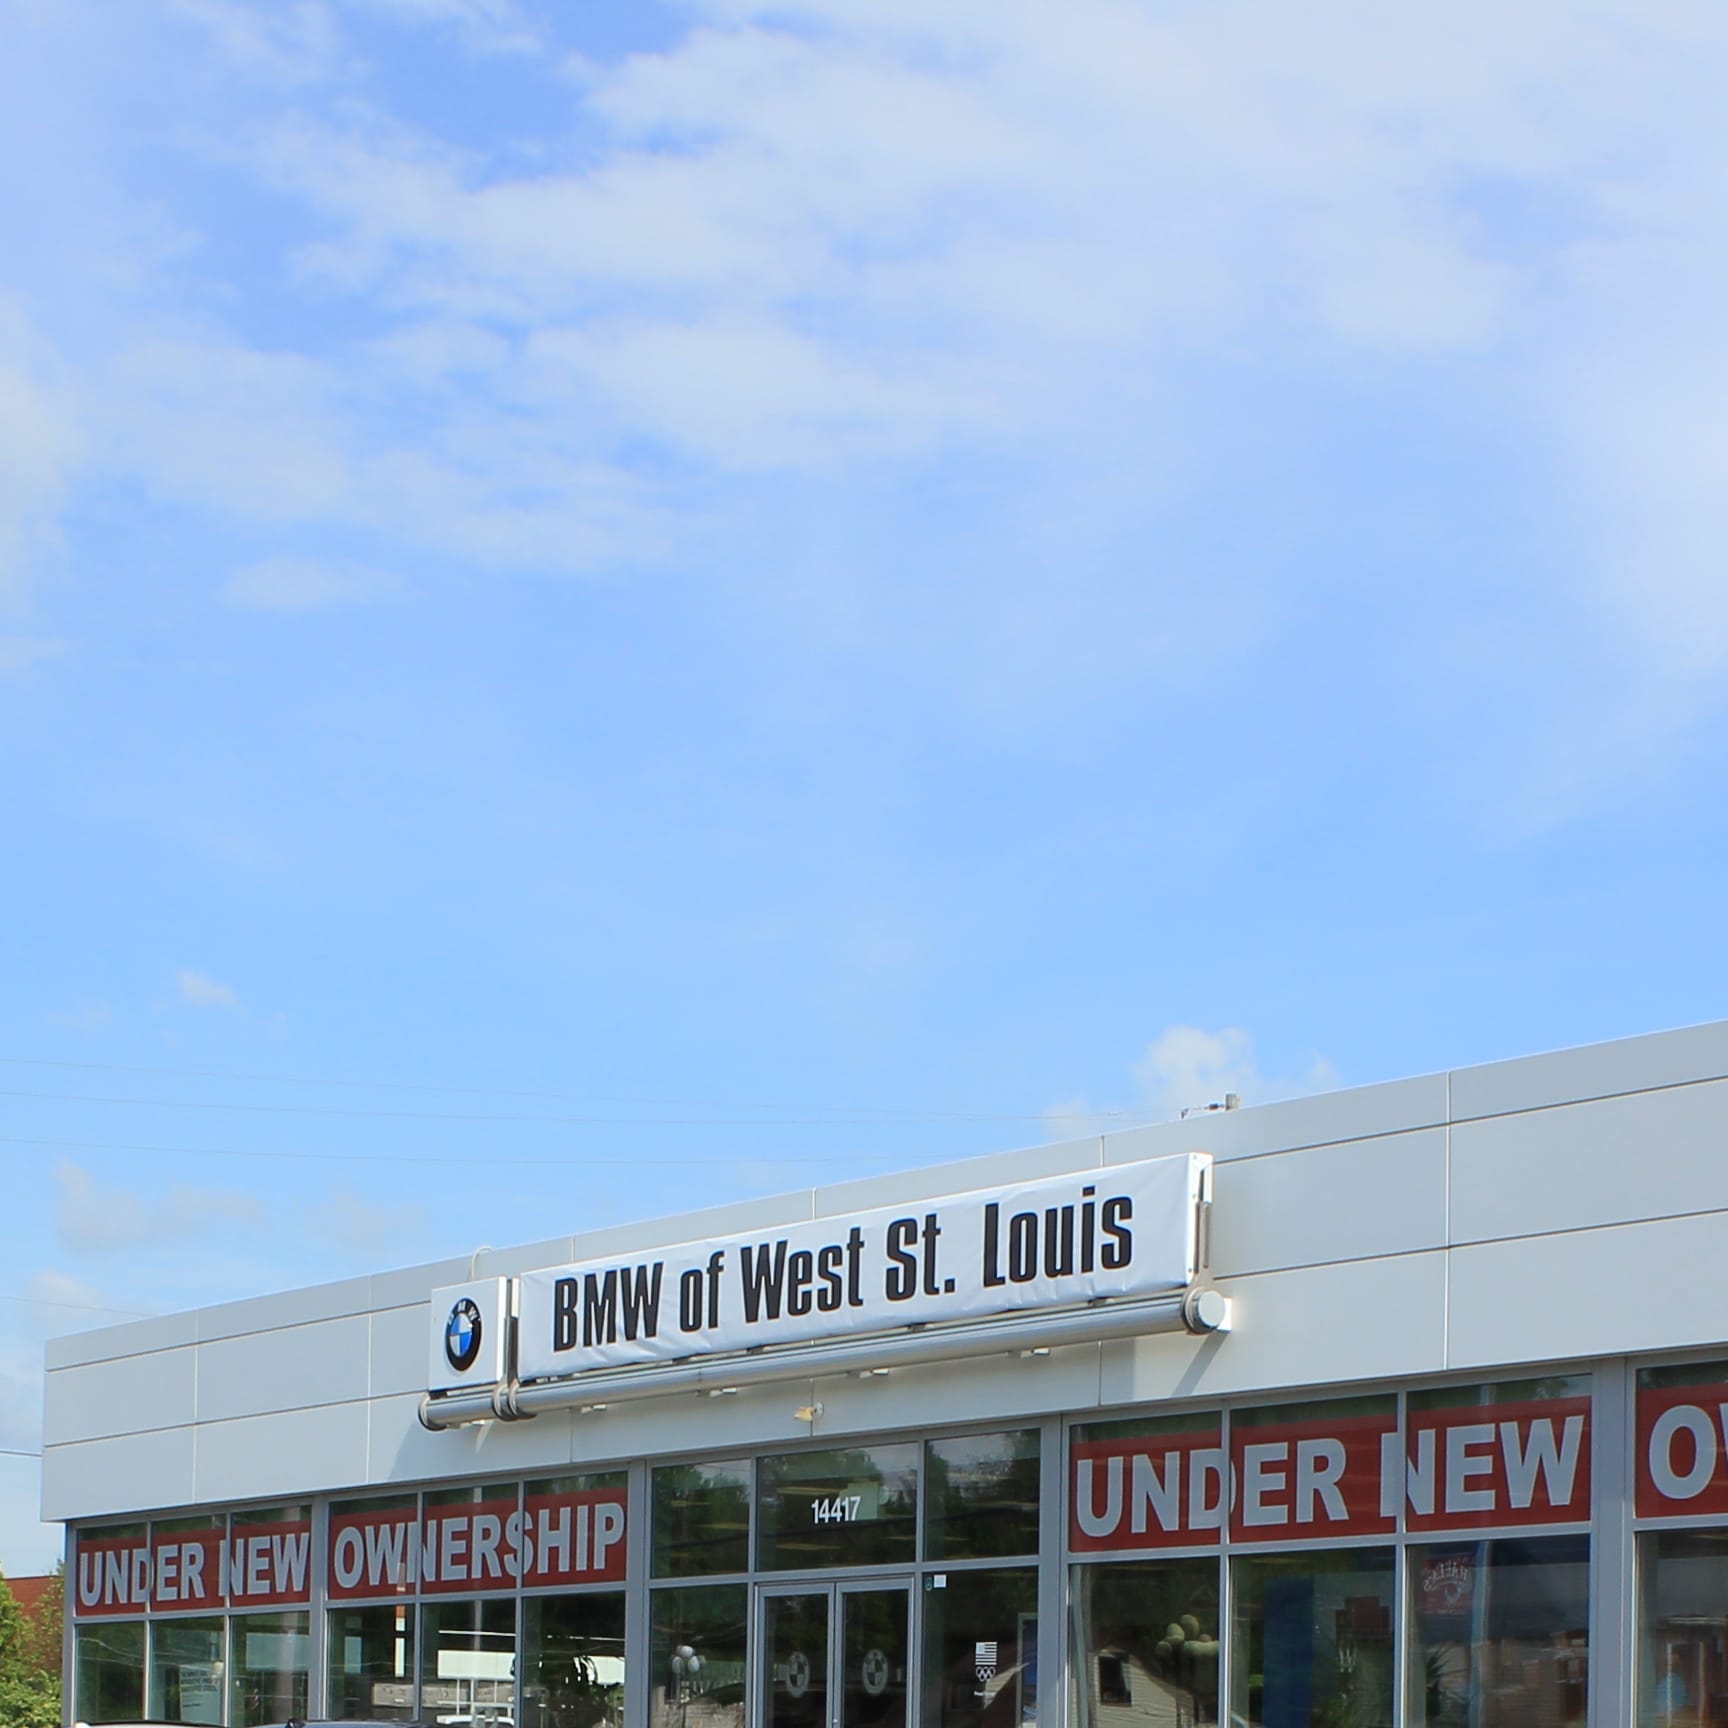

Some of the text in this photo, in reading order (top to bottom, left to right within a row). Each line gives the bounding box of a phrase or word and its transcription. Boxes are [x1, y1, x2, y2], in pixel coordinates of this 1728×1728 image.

[553, 1186, 1134, 1352] BMW of West St. Louis
[811, 1496, 861, 1524] 14417
[1076, 1415, 1585, 1538] UNDER NEW
[79, 1502, 625, 1607] UNDER NEW OWNERSHIP
